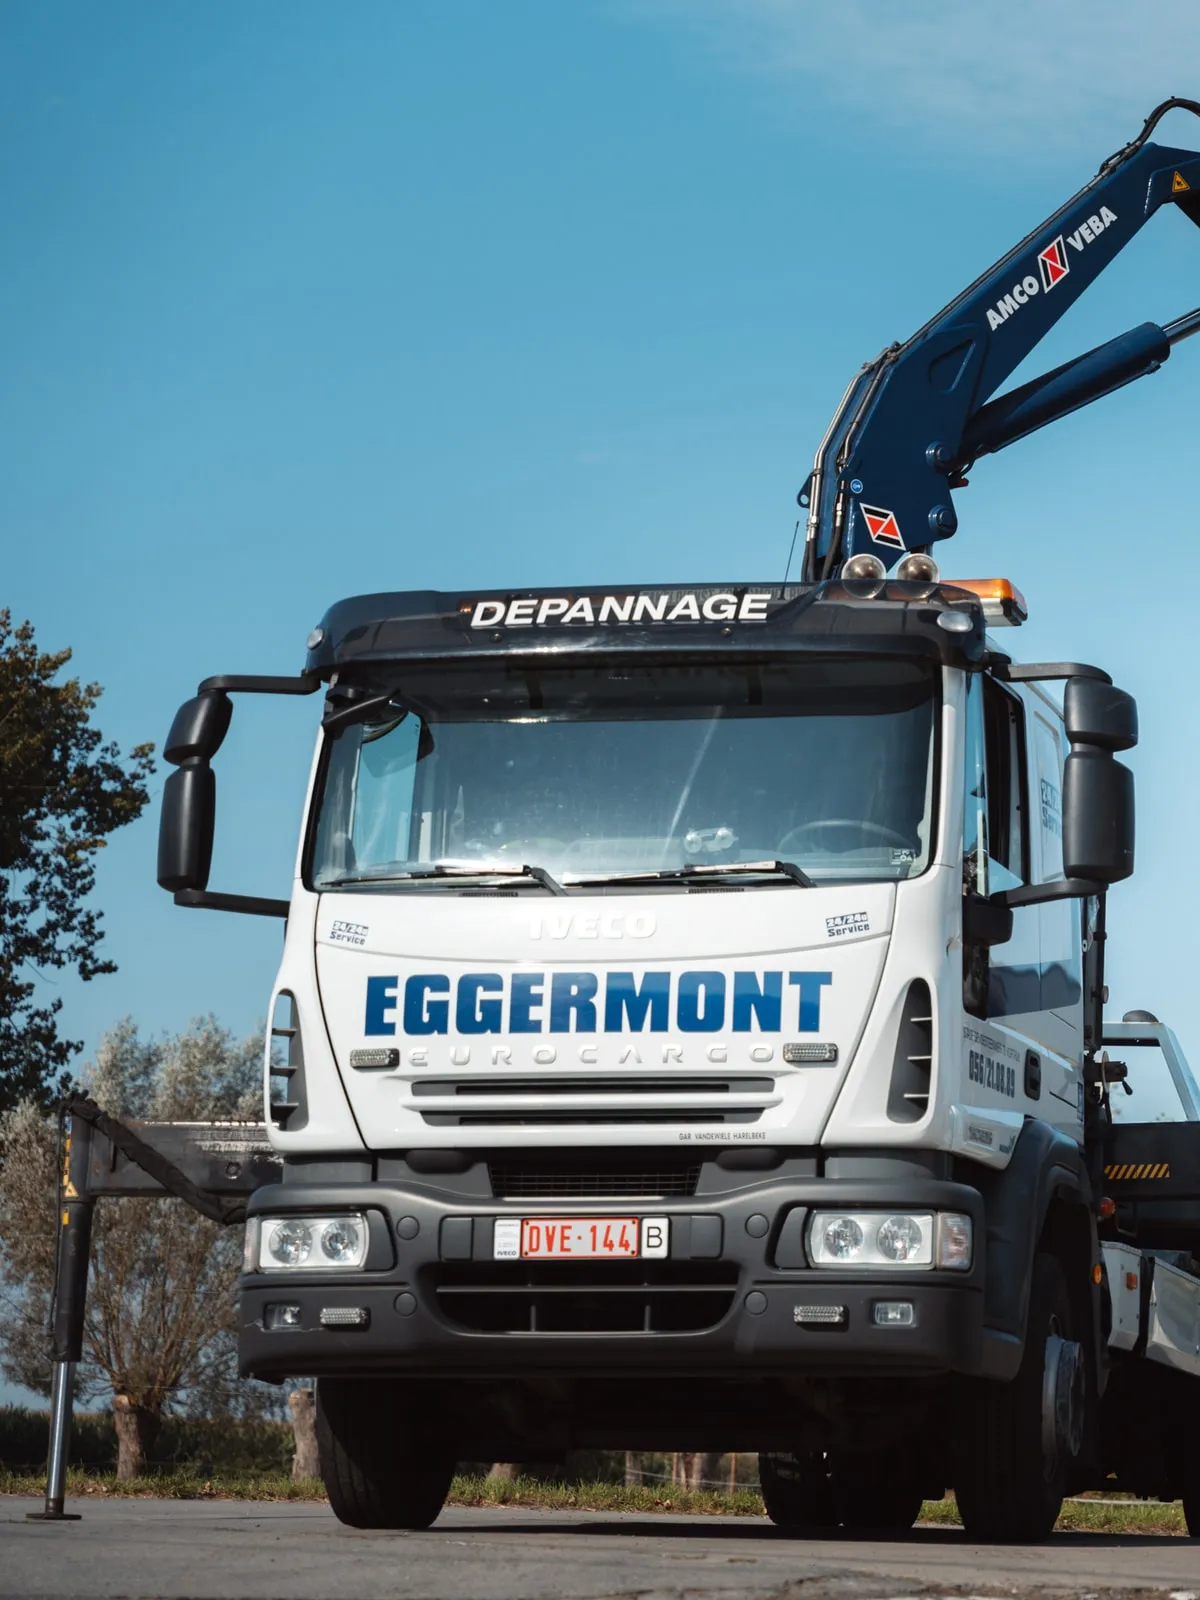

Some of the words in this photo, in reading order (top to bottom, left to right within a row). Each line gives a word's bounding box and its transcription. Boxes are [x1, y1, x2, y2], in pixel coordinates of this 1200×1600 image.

[986, 275, 1040, 331] AMCO
[1066, 206, 1118, 252] VEBA
[470, 594, 772, 627] DEPANNAGE
[329, 930, 366, 946] Service
[526, 907, 658, 941] IVECO
[828, 923, 870, 937] Service
[364, 970, 833, 1036] EGGERMONT
[407, 1044, 776, 1068] EUROCARGO
[646, 1226, 663, 1248] B
